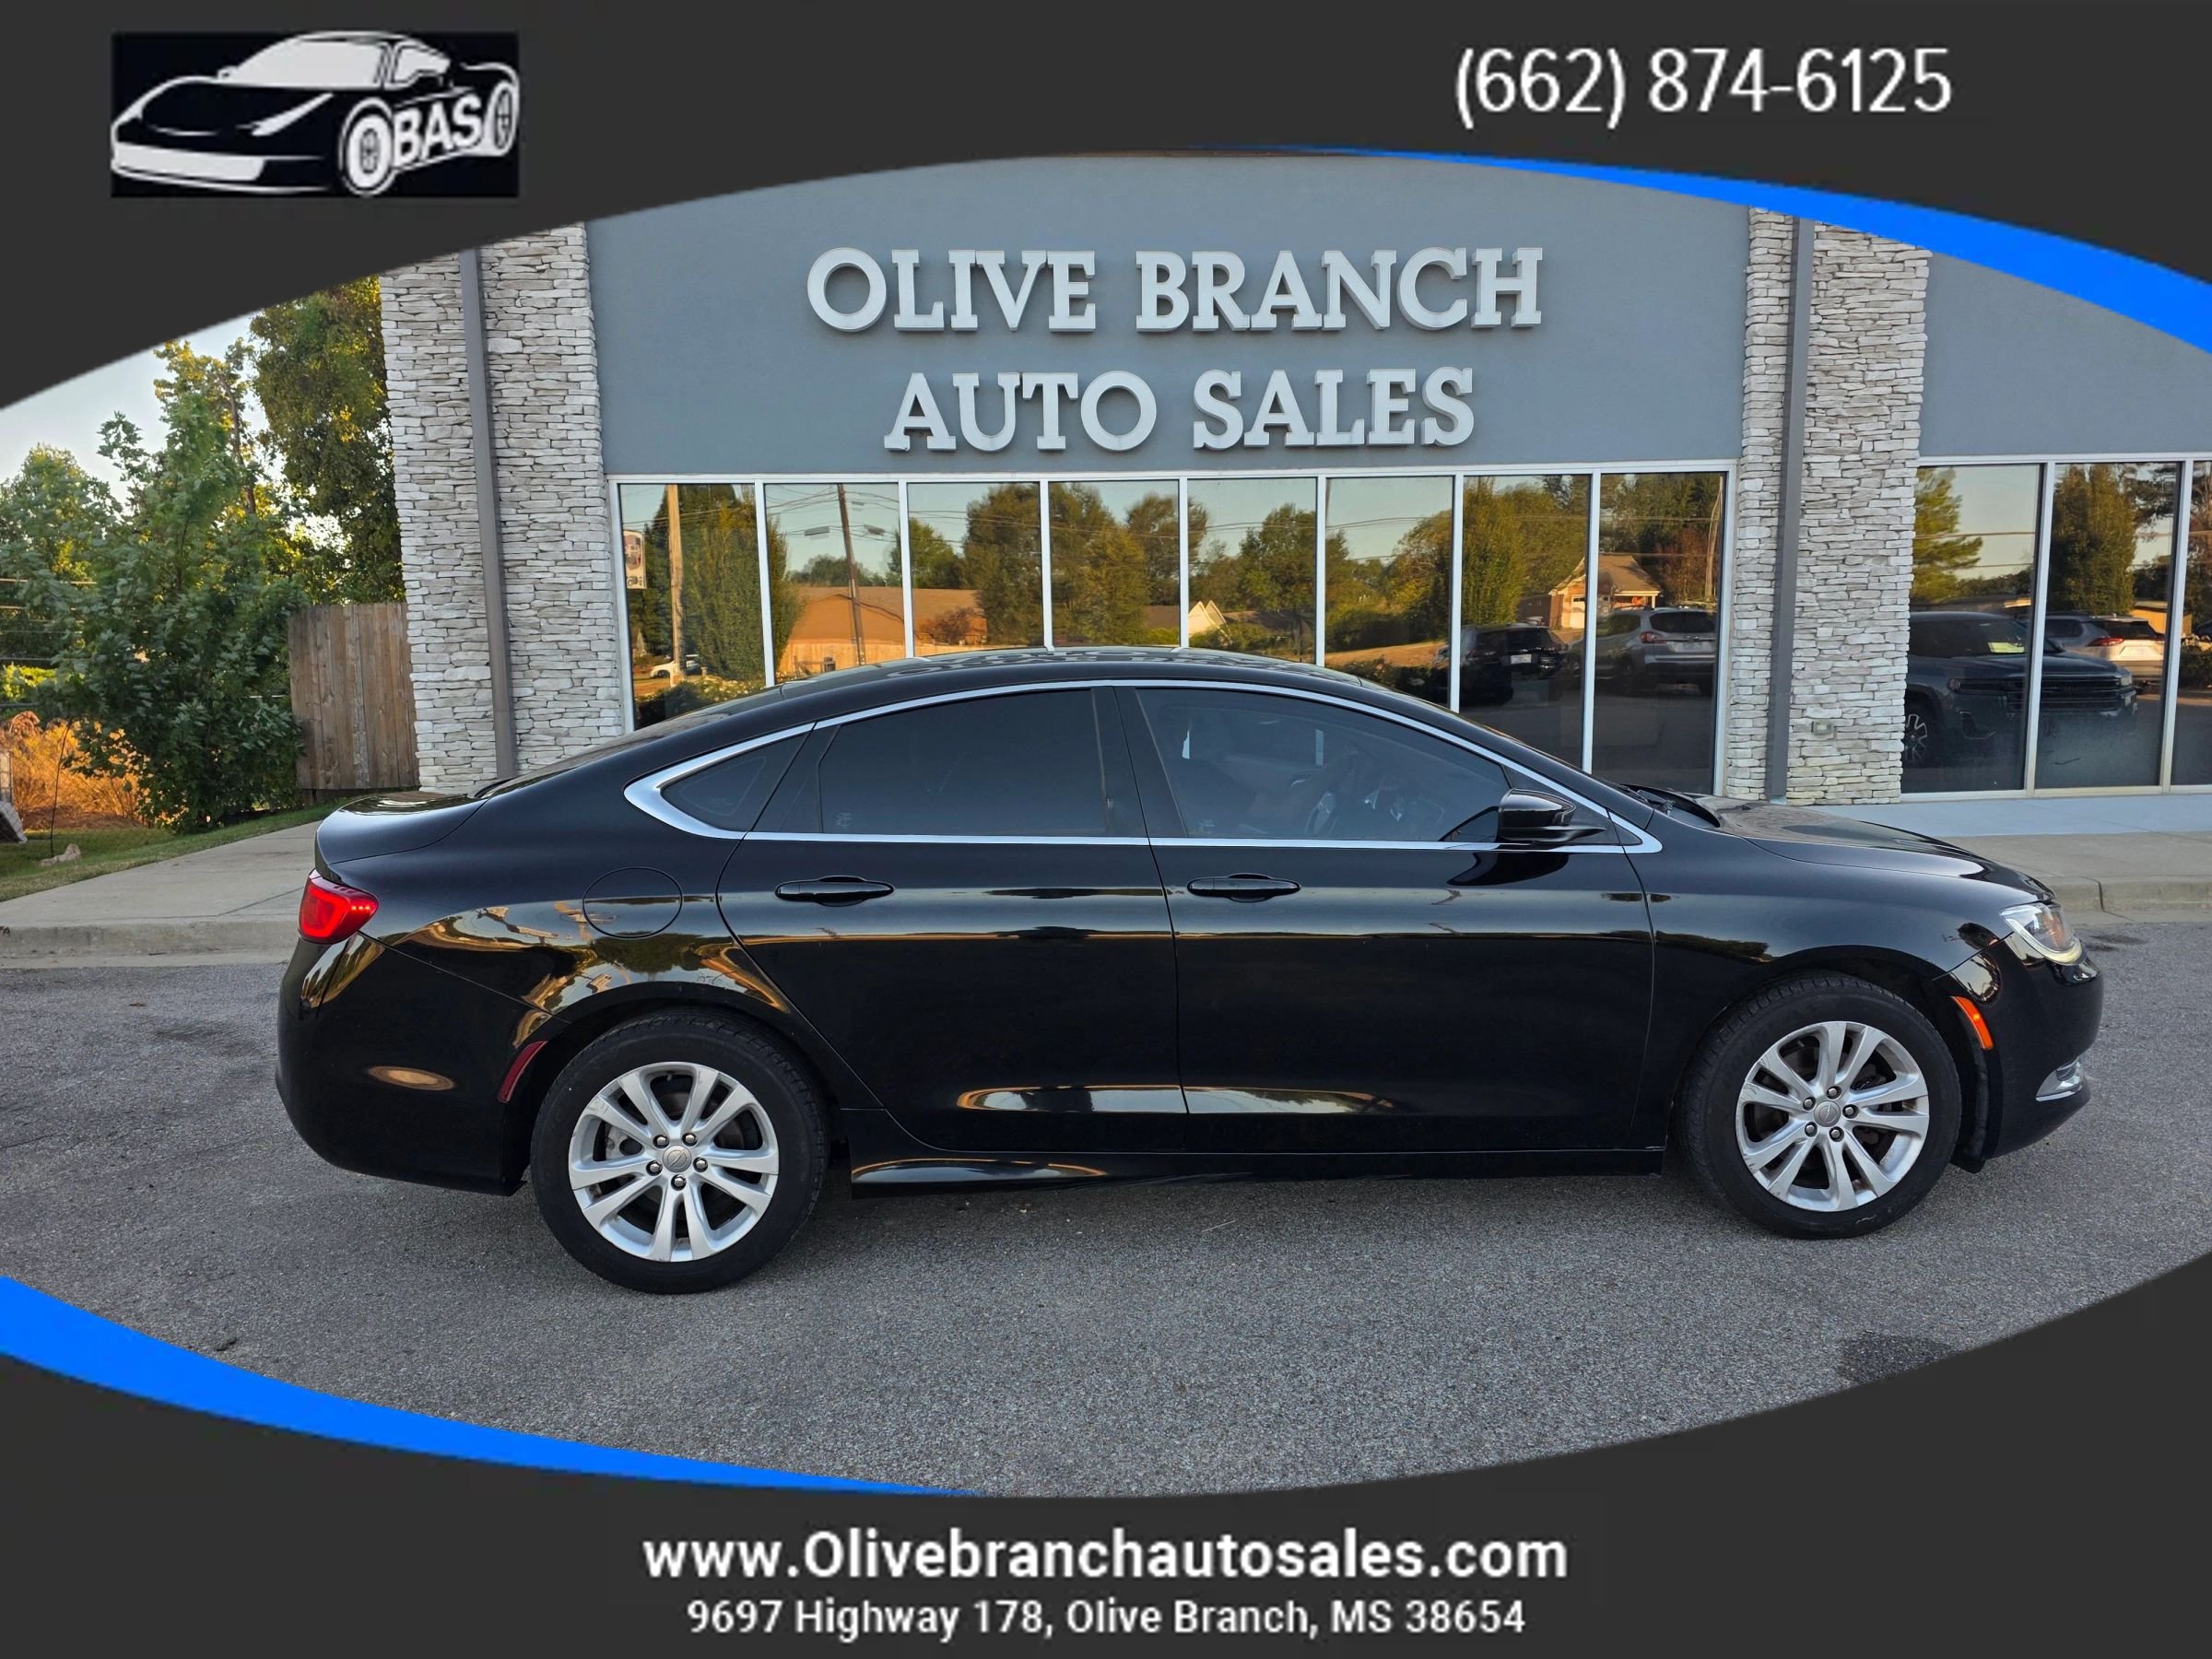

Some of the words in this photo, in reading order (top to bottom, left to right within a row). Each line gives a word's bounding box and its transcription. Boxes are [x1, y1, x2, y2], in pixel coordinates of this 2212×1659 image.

[806, 247, 1097, 333] OLIVE
[1135, 246, 1545, 333] BRANCH
[883, 370, 1158, 453] AUTO
[1192, 366, 1476, 451] SALES
